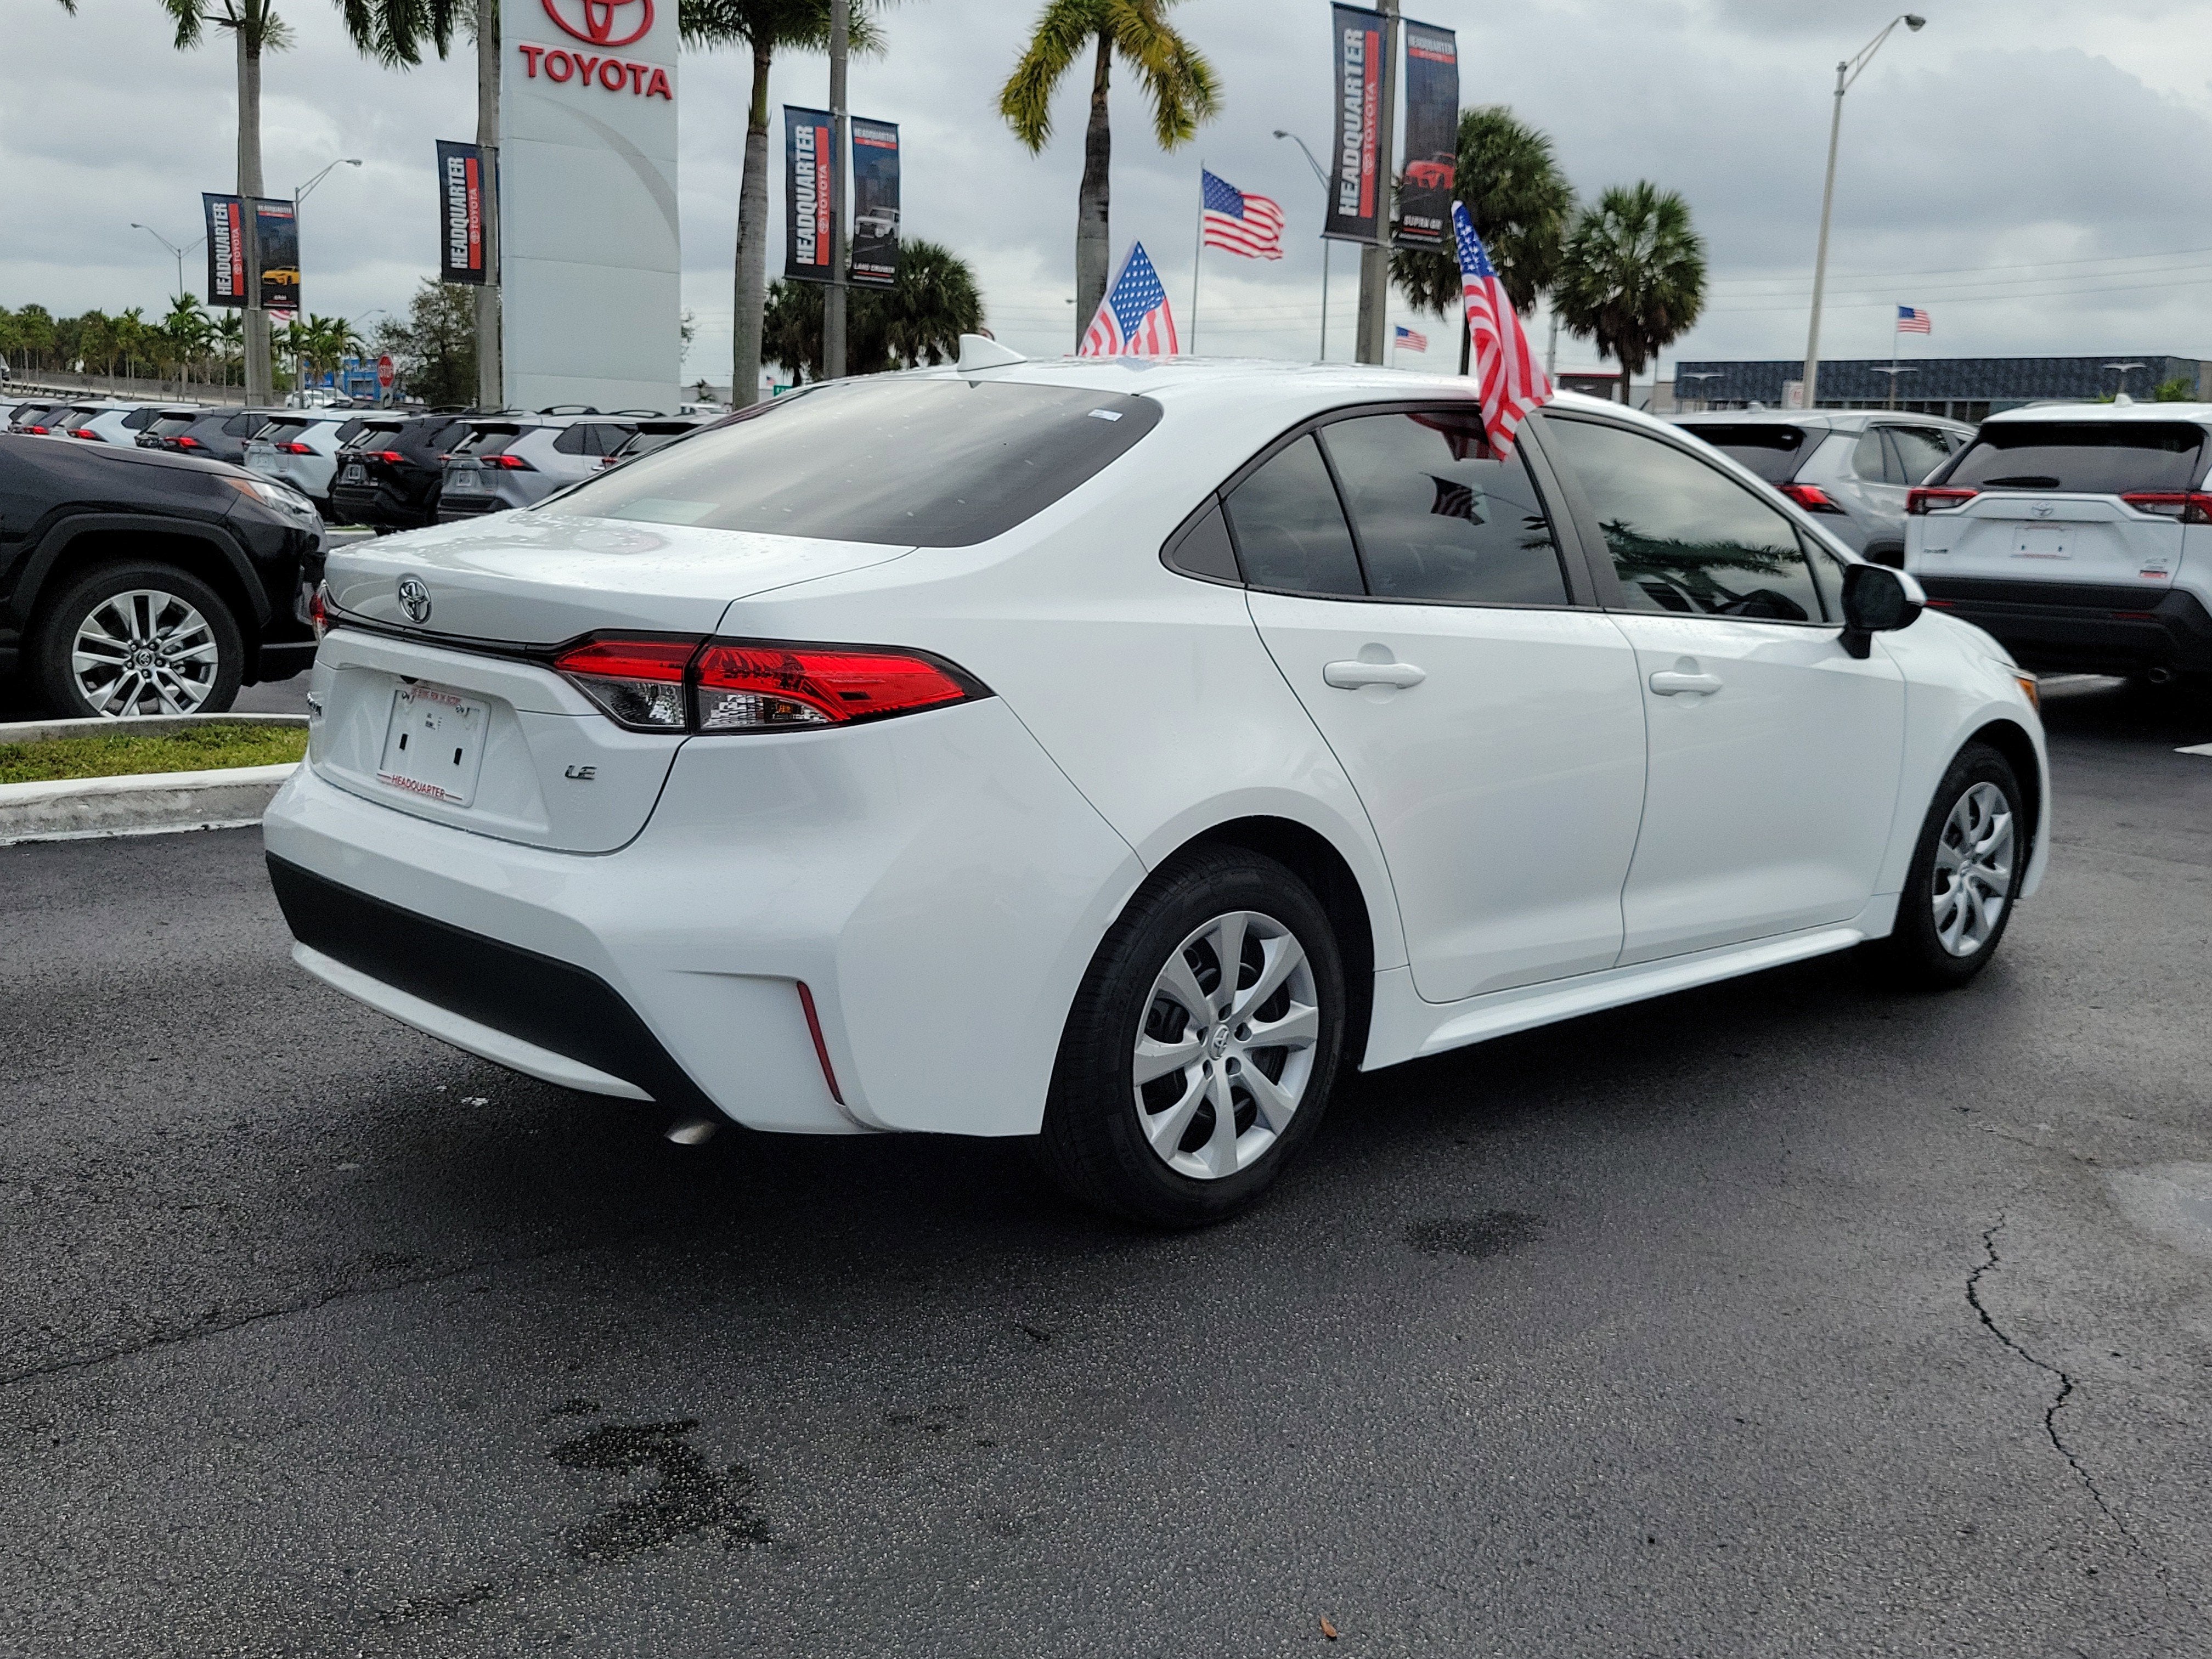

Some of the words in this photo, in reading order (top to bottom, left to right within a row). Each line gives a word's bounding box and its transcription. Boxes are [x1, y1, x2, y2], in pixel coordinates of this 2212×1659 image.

[520, 45, 673, 100] TOYOTA
[1338, 28, 1364, 217] HEADQUARTER
[1363, 82, 1376, 148] TOYOTA
[447, 156, 469, 269] HEADQUARTER
[469, 188, 481, 230] TOYOTA
[795, 125, 817, 264] HEADQUARTER
[817, 164, 829, 213] TOYOTA
[212, 202, 232, 296] HEADQUARTER
[392, 774, 445, 799] HEADQUARTER
[565, 765, 597, 780] LE
